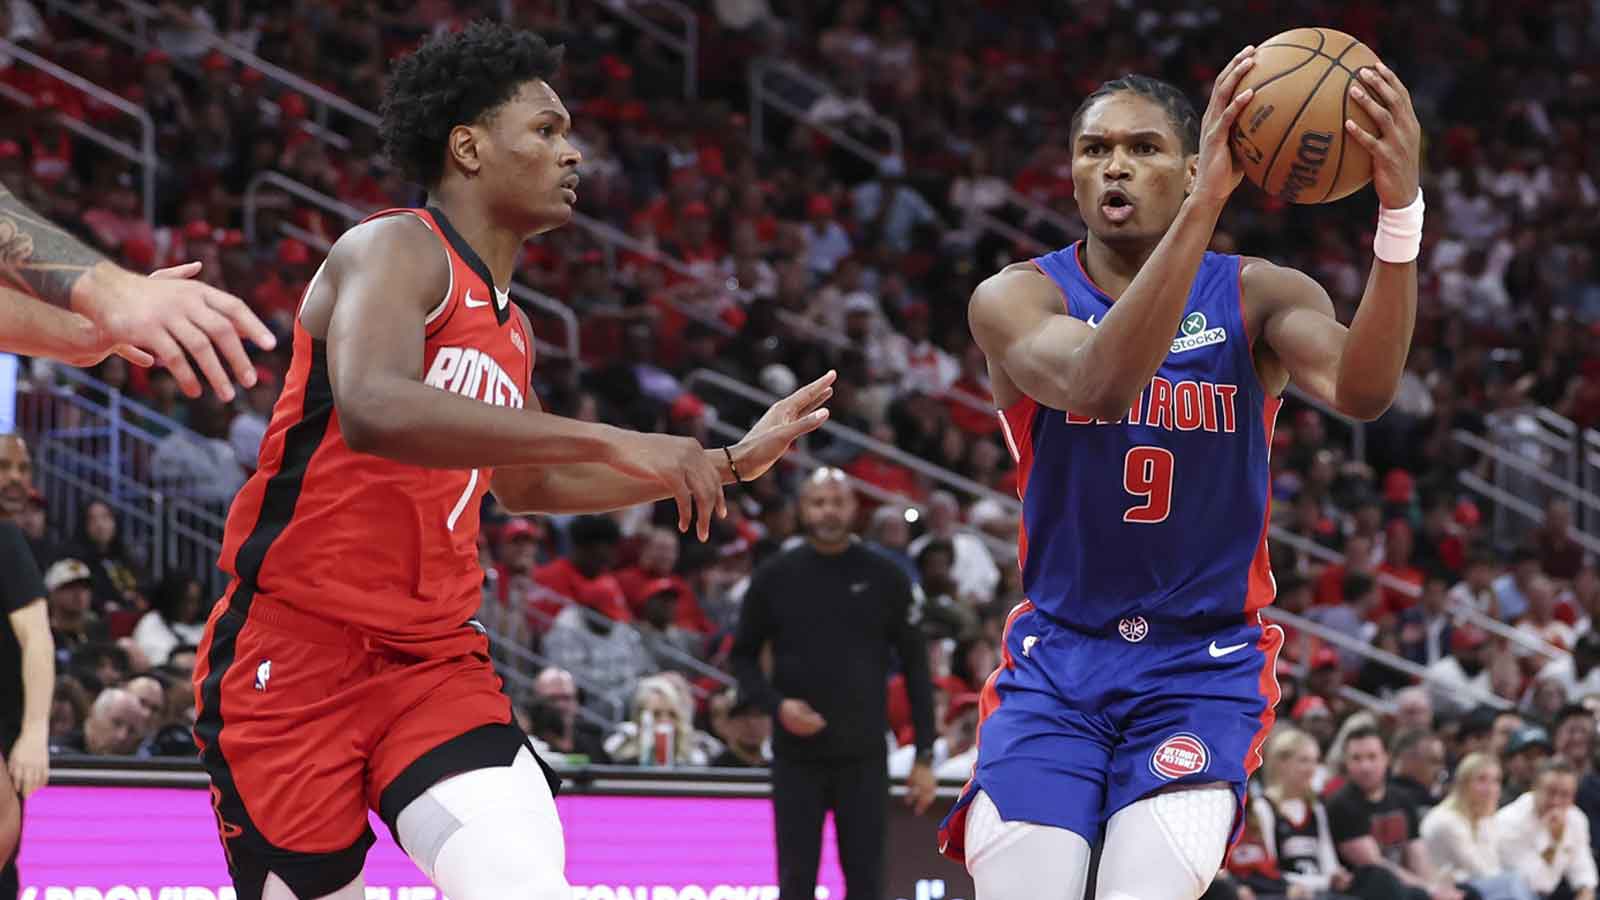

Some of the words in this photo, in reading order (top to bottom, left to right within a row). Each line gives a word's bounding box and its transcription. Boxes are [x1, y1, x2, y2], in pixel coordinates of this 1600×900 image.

[1172, 329, 1225, 351] StockX
[1066, 376, 1237, 432] ROIT
[1123, 446, 1174, 523] 9
